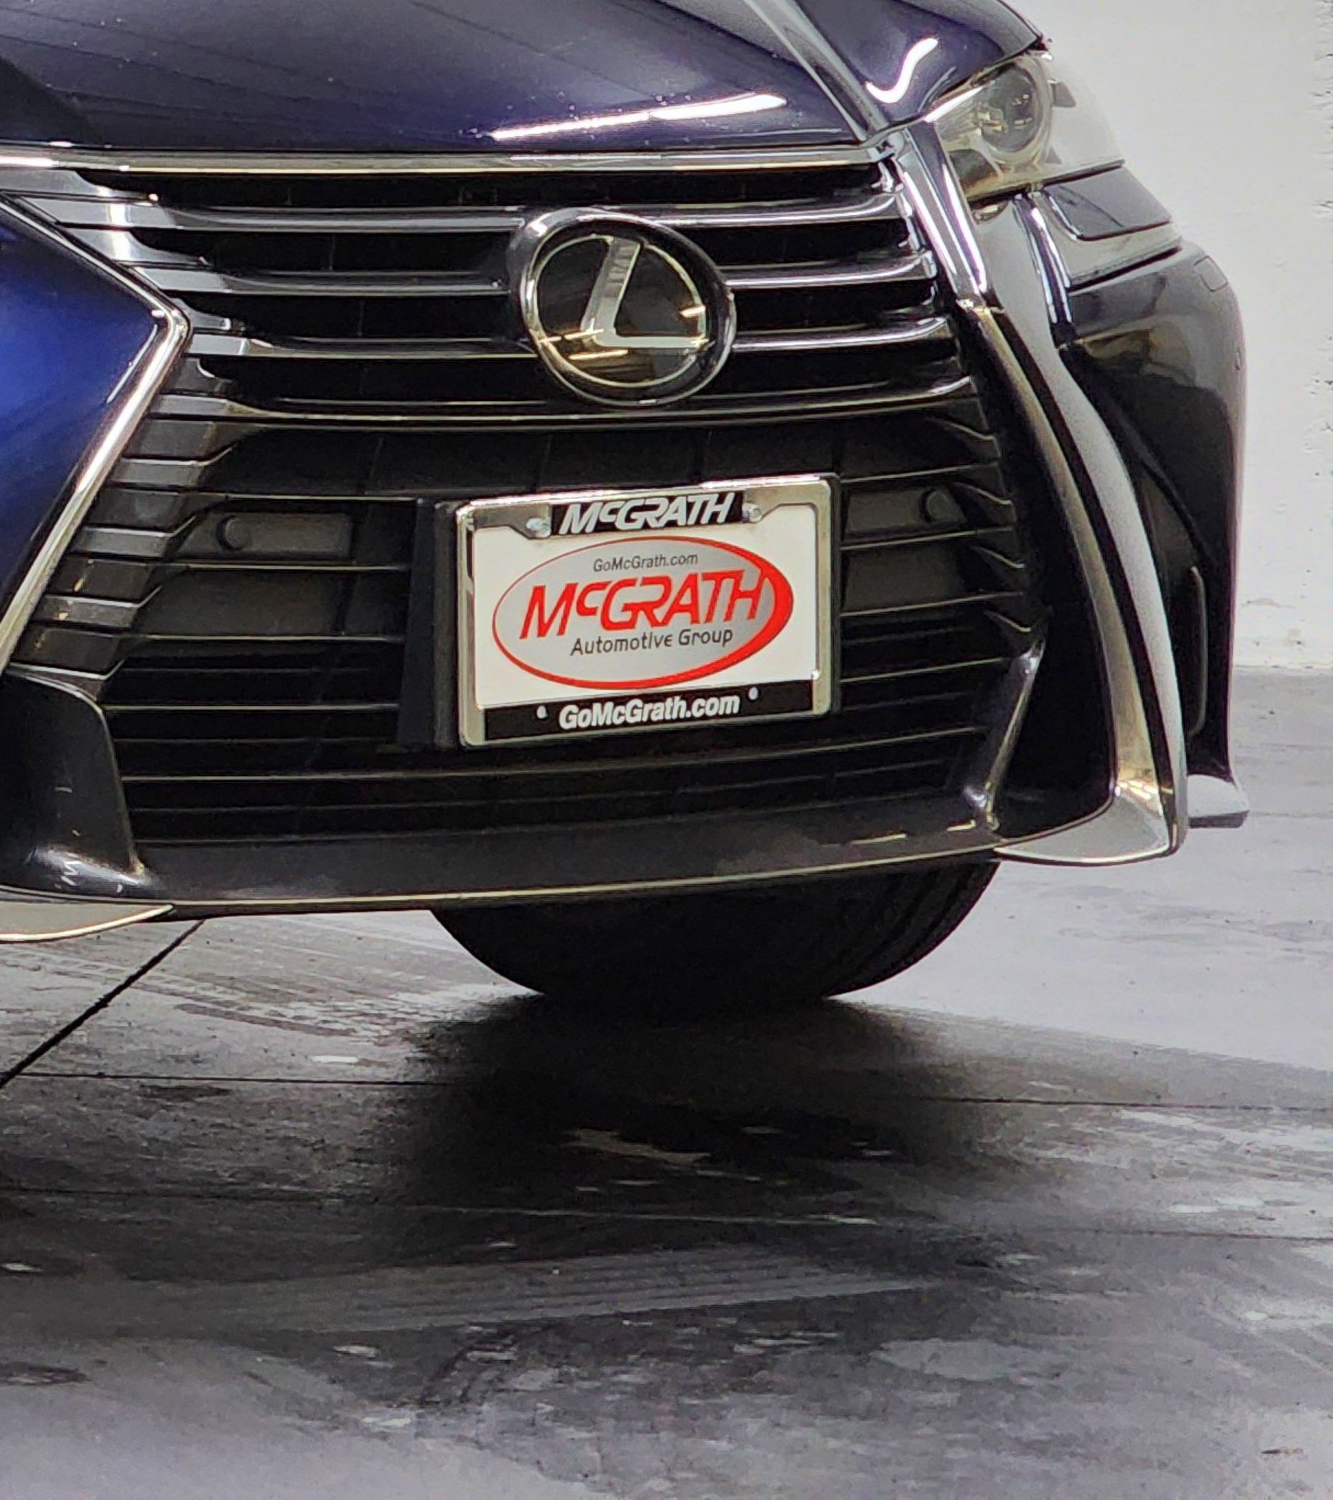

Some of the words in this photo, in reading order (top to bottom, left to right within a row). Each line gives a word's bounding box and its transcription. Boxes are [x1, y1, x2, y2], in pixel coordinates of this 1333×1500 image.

[593, 552, 698, 573] GoMcGrath.com
[570, 630, 674, 657] Automotive
[678, 627, 734, 649] Group
[559, 692, 741, 731] GoMcGrath.com
